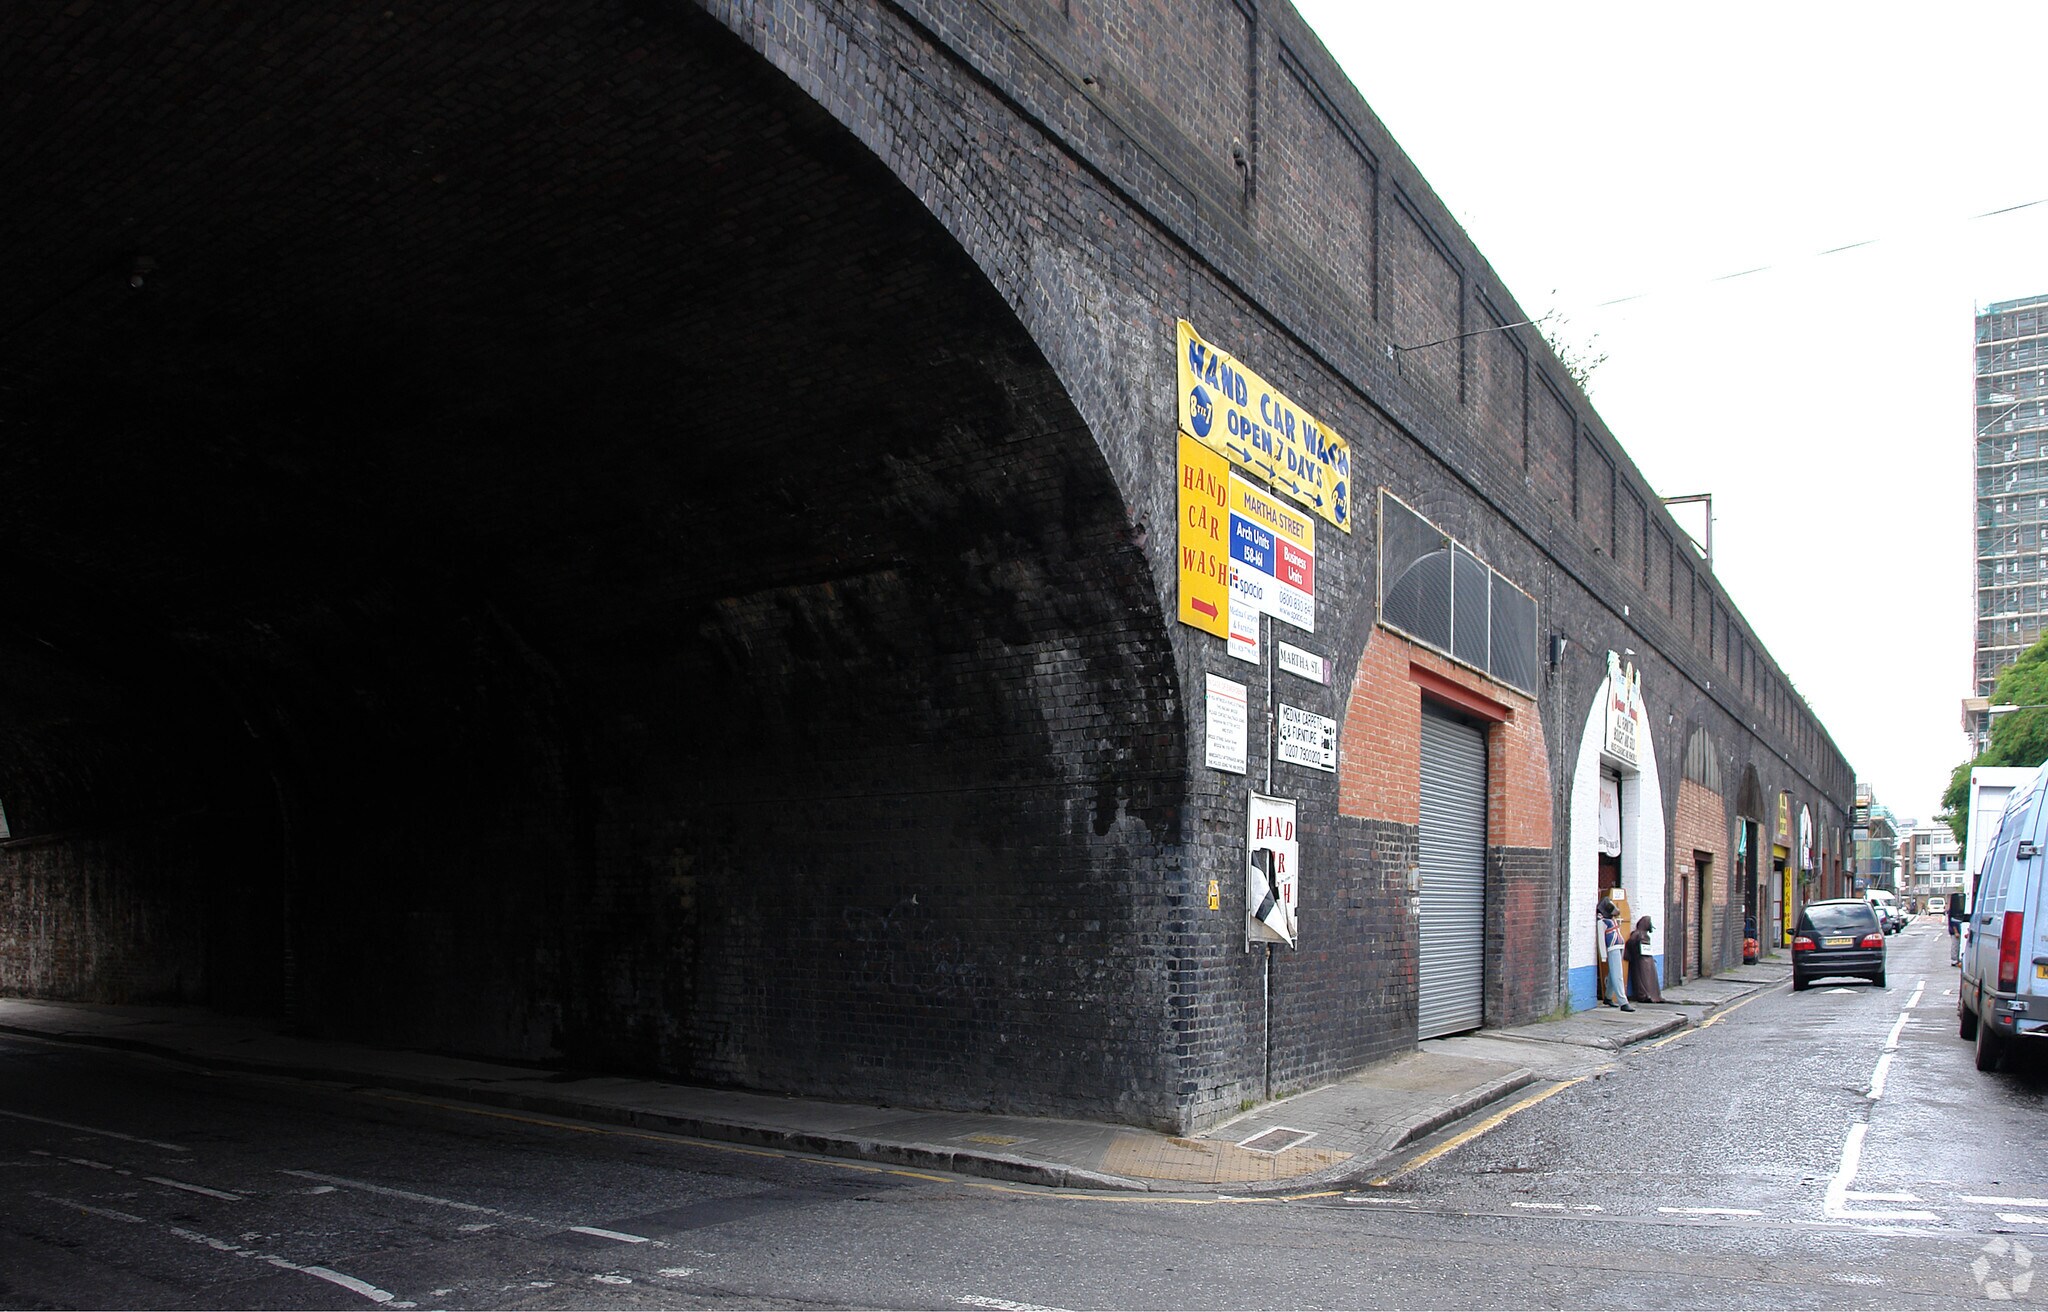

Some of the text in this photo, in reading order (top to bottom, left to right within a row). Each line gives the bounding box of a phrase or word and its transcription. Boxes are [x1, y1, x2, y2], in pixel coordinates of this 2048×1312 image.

[1189, 338, 1350, 478] HAND CAR WASH
[1227, 408, 1323, 488] OPEN 7 DAYS
[1183, 464, 1227, 508] HAND
[1188, 505, 1220, 541] CAR
[1244, 492, 1305, 540] MARTHA STREET
[1236, 521, 1270, 551] Arch Units
[1183, 545, 1228, 587] WASH
[1283, 545, 1307, 571] Business
[1288, 566, 1304, 586] Units
[1280, 648, 1309, 671] MARTHA
[1282, 706, 1322, 730] MEDINA CARPETS
[1286, 725, 1291, 738] &
[1256, 815, 1294, 842] HAND
